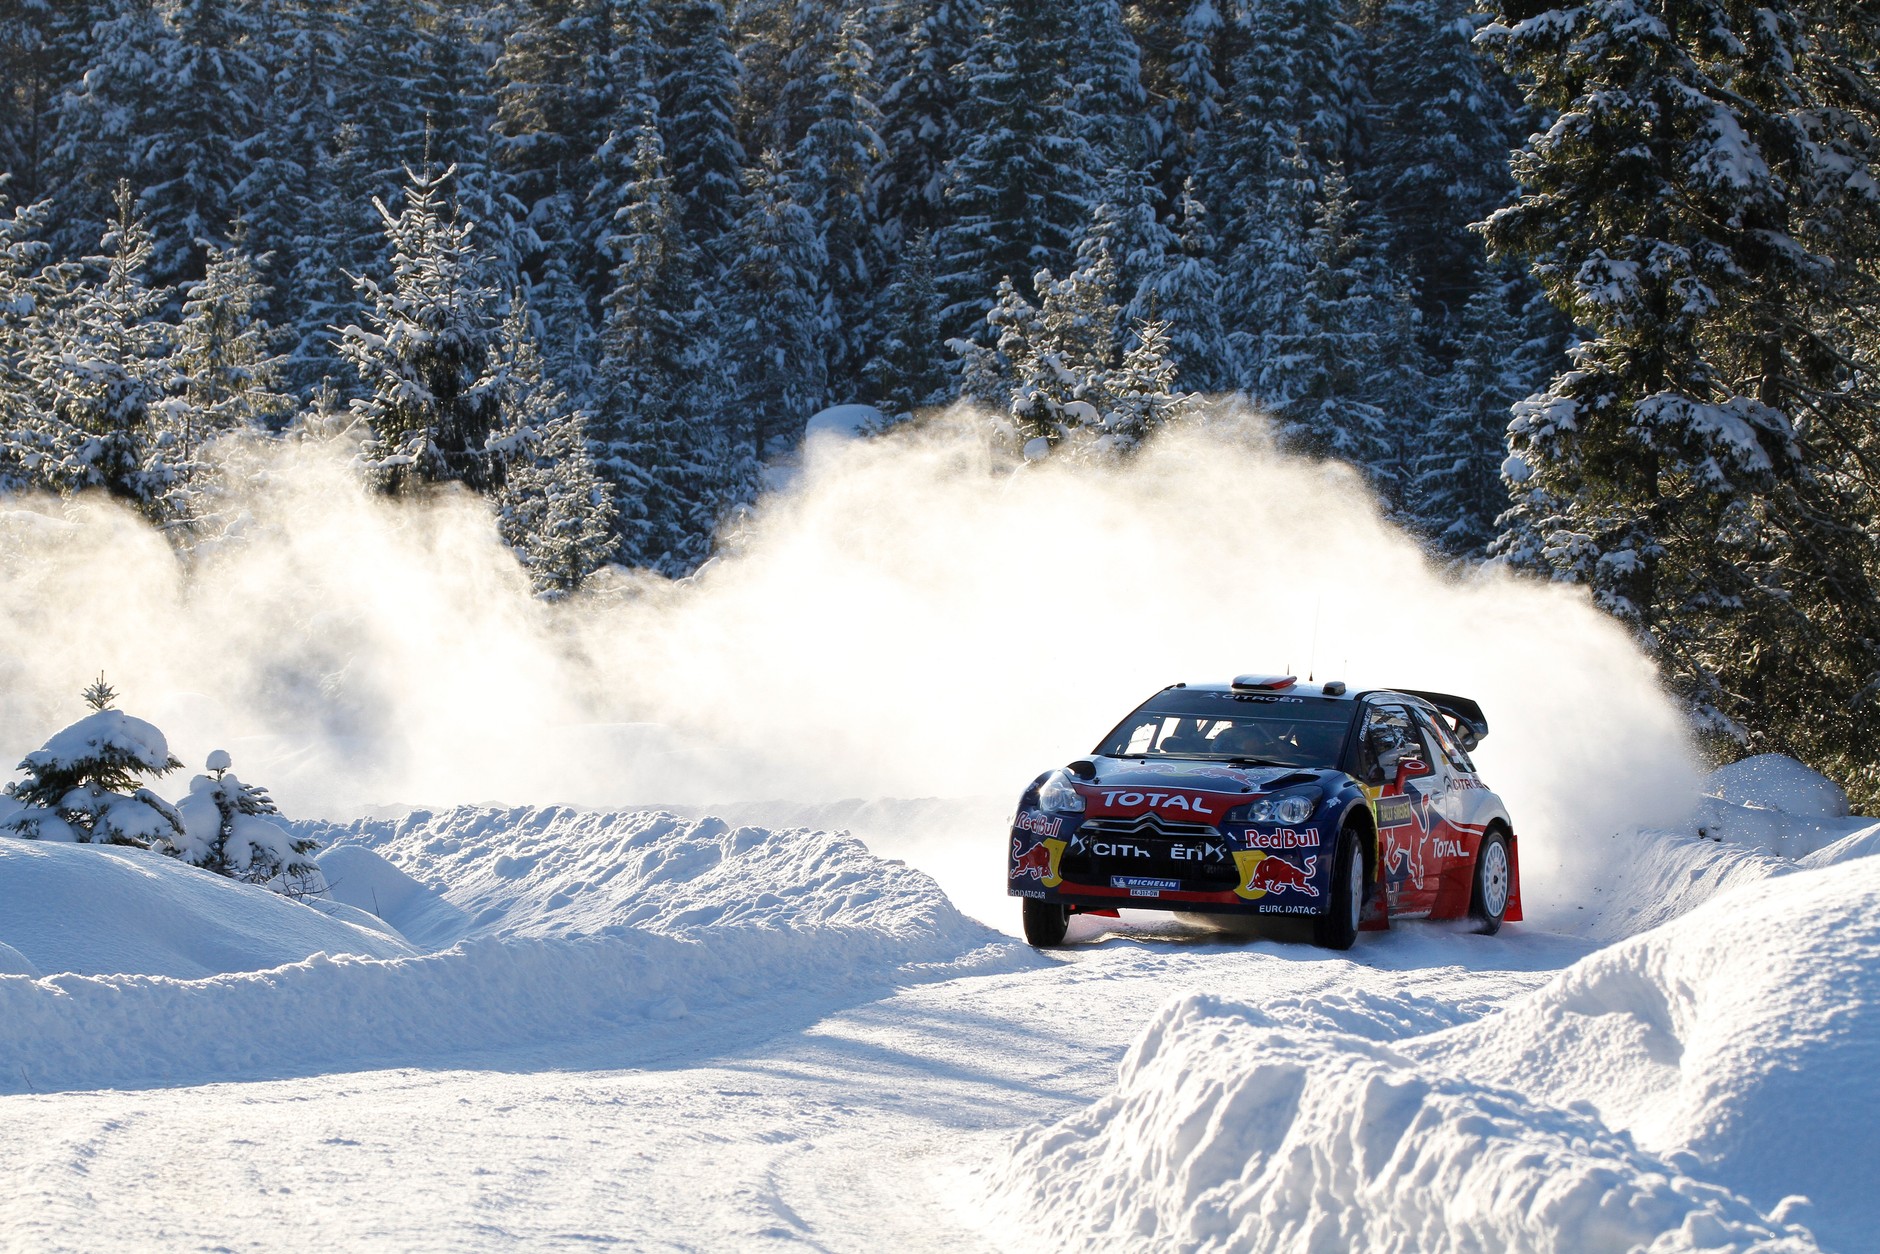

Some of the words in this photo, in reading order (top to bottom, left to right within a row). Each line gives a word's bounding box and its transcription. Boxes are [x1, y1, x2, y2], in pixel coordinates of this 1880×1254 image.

[1101, 790, 1213, 814] TOTAL
[1014, 811, 1040, 833] Red
[1038, 814, 1063, 837] Bull
[1245, 828, 1282, 848] Red
[1282, 828, 1320, 848] Bull
[1432, 837, 1470, 859] TOTAL
[1127, 879, 1177, 888] MICHELIN
